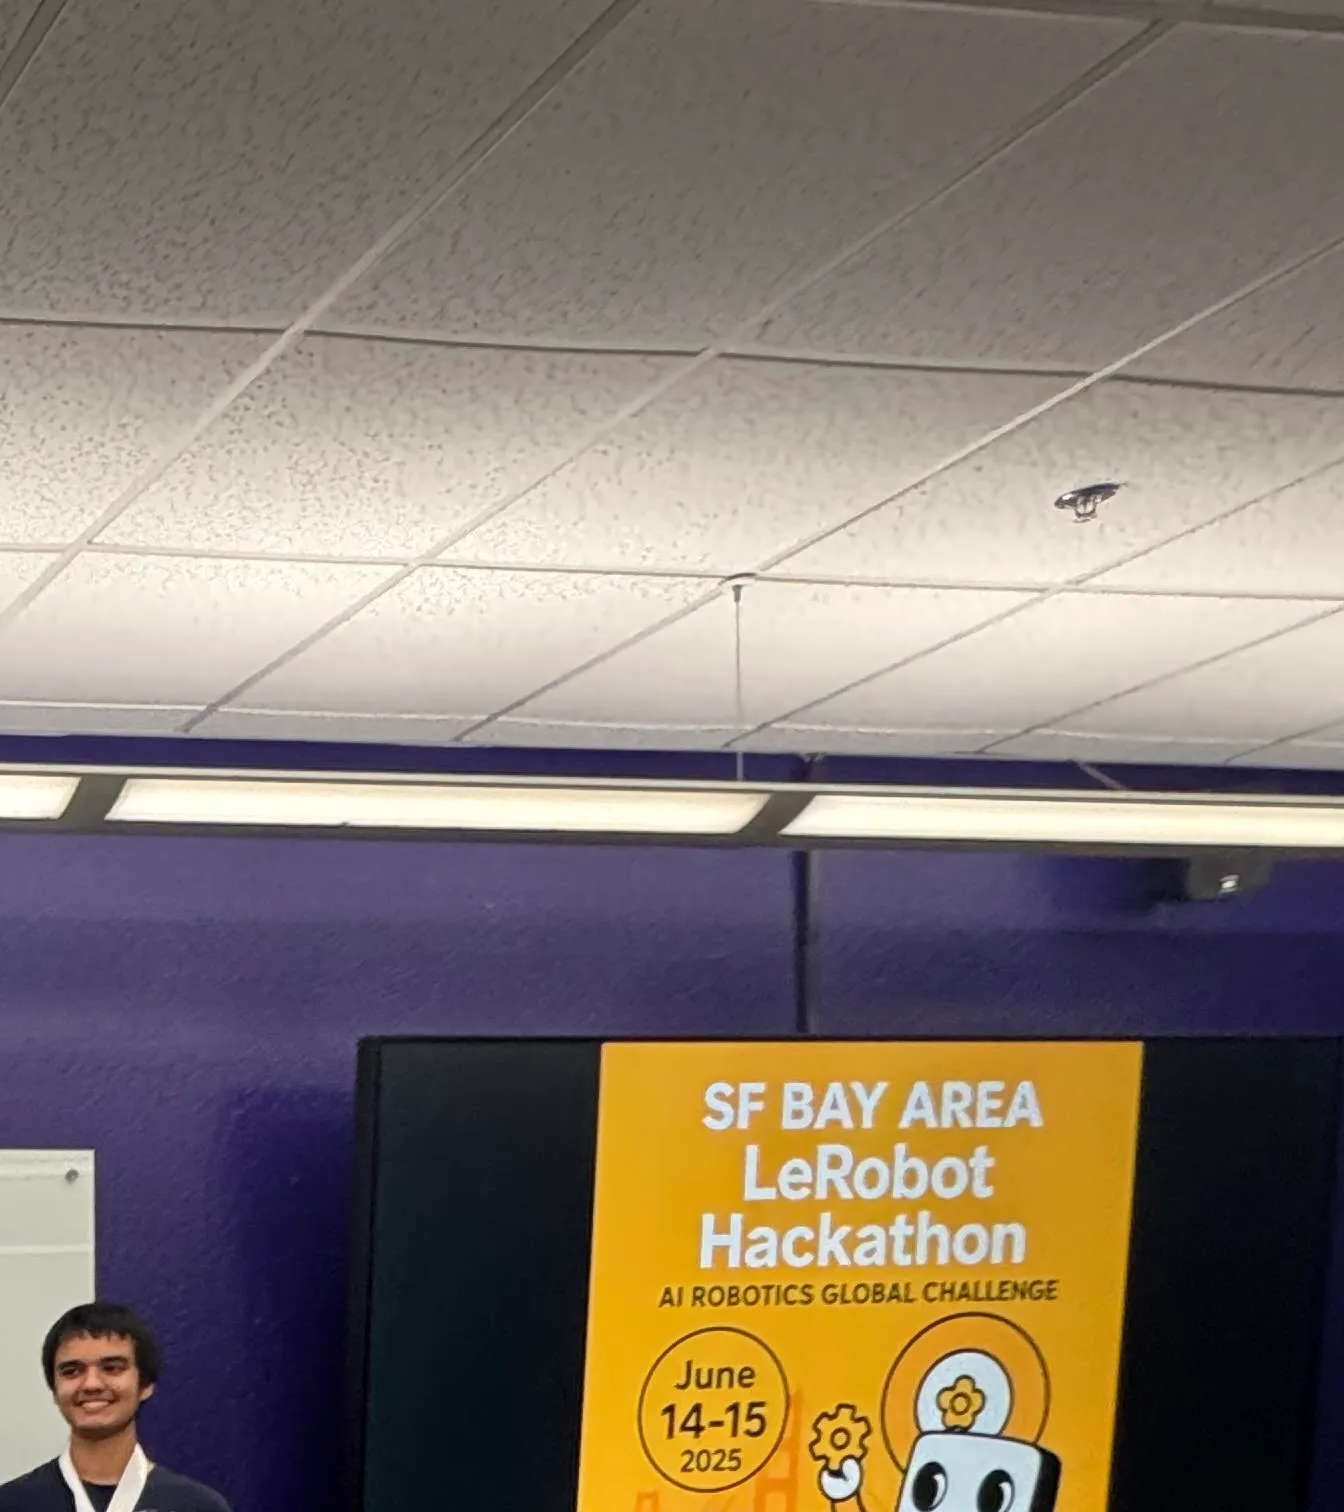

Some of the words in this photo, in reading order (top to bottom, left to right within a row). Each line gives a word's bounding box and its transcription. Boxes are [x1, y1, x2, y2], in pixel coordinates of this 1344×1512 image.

[702, 1081, 767, 1131] SF
[781, 1081, 889, 1130] BAY
[898, 1080, 1044, 1129] AREA
[743, 1142, 995, 1202] LeRobot
[699, 1210, 1026, 1269] Hackathon
[659, 1286, 683, 1307] AI
[692, 1283, 814, 1308] ROBOTICS
[822, 1282, 915, 1305] GLOBAL
[923, 1278, 1059, 1303] CHALLENGE
[675, 1360, 755, 1390] June
[661, 1401, 767, 1440] 14-15
[681, 1448, 742, 1473] 2025
